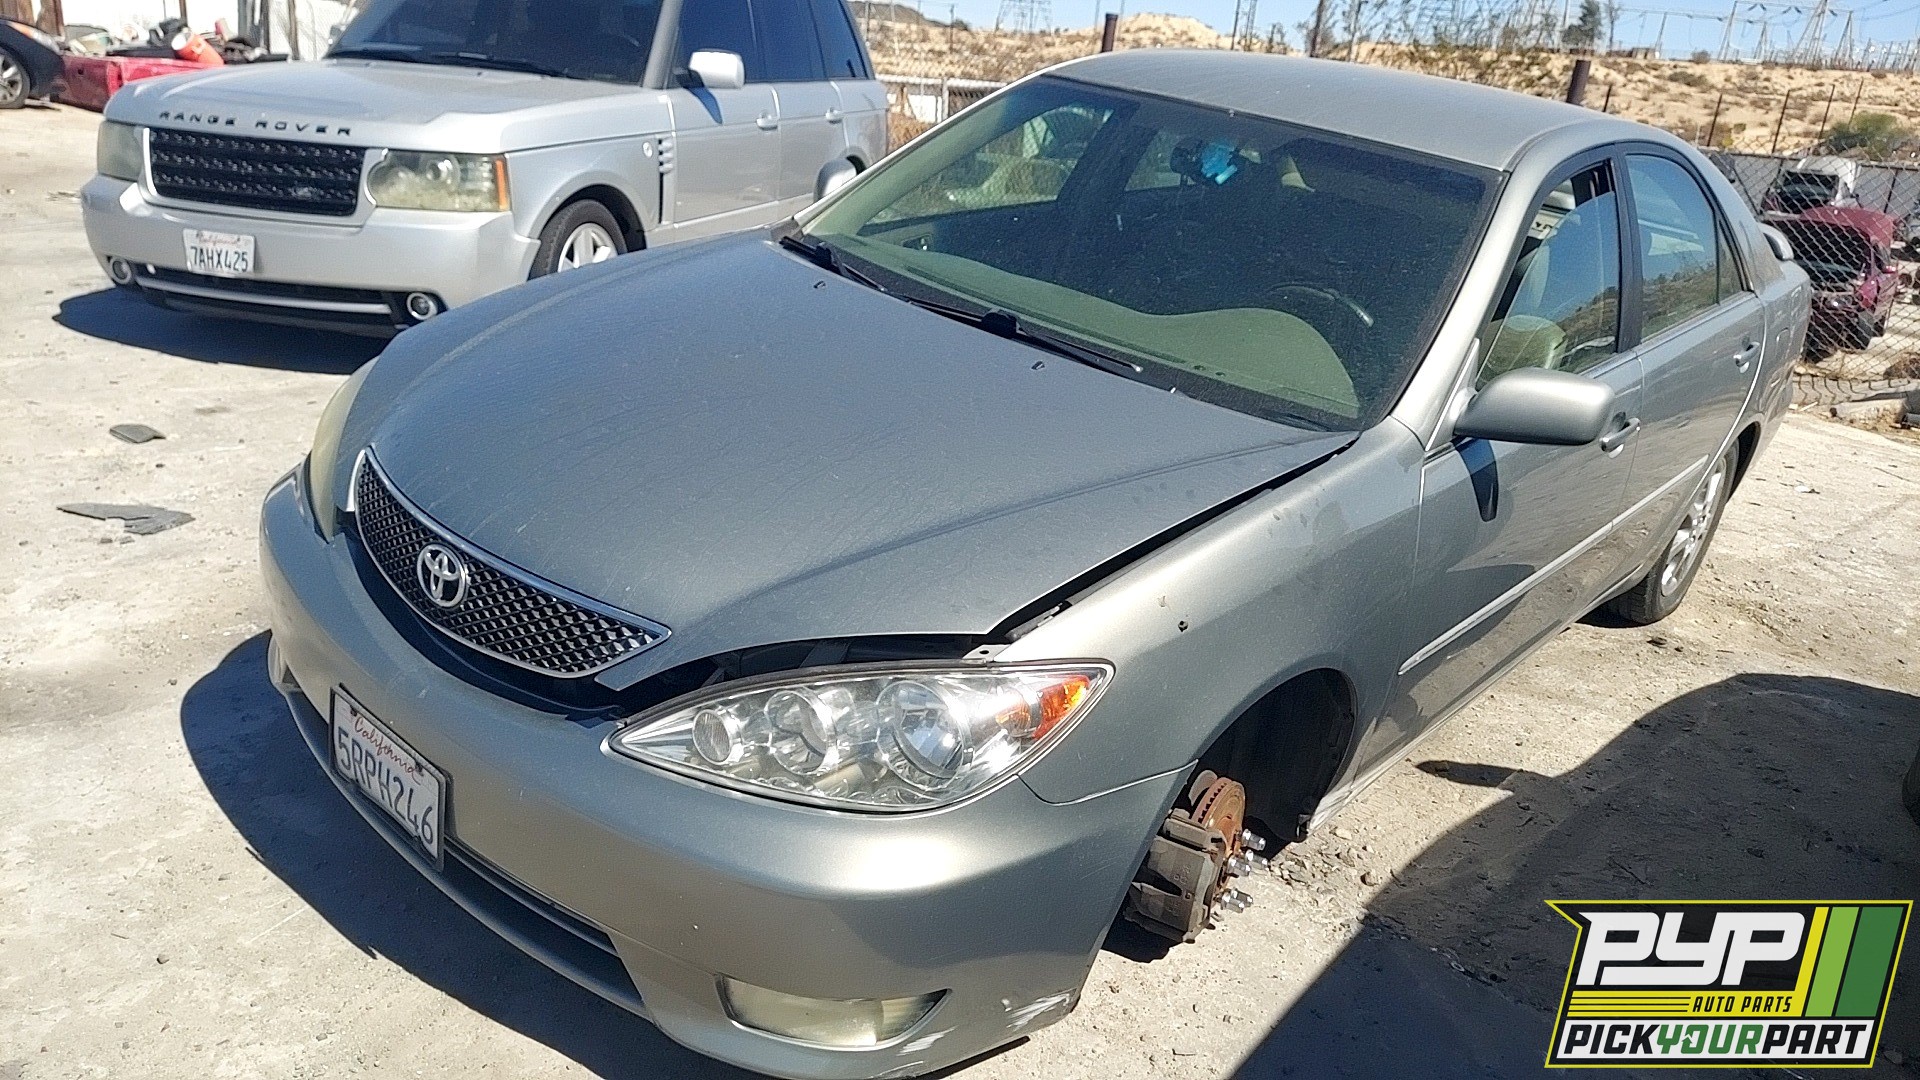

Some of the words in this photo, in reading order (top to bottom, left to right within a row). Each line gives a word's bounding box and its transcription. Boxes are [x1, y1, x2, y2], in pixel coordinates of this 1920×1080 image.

[159, 111, 236, 126] RANGE
[255, 119, 350, 136] ROVER
[190, 246, 248, 272] 7AHX425
[354, 716, 421, 785] California
[338, 726, 433, 845] 5RPH246
